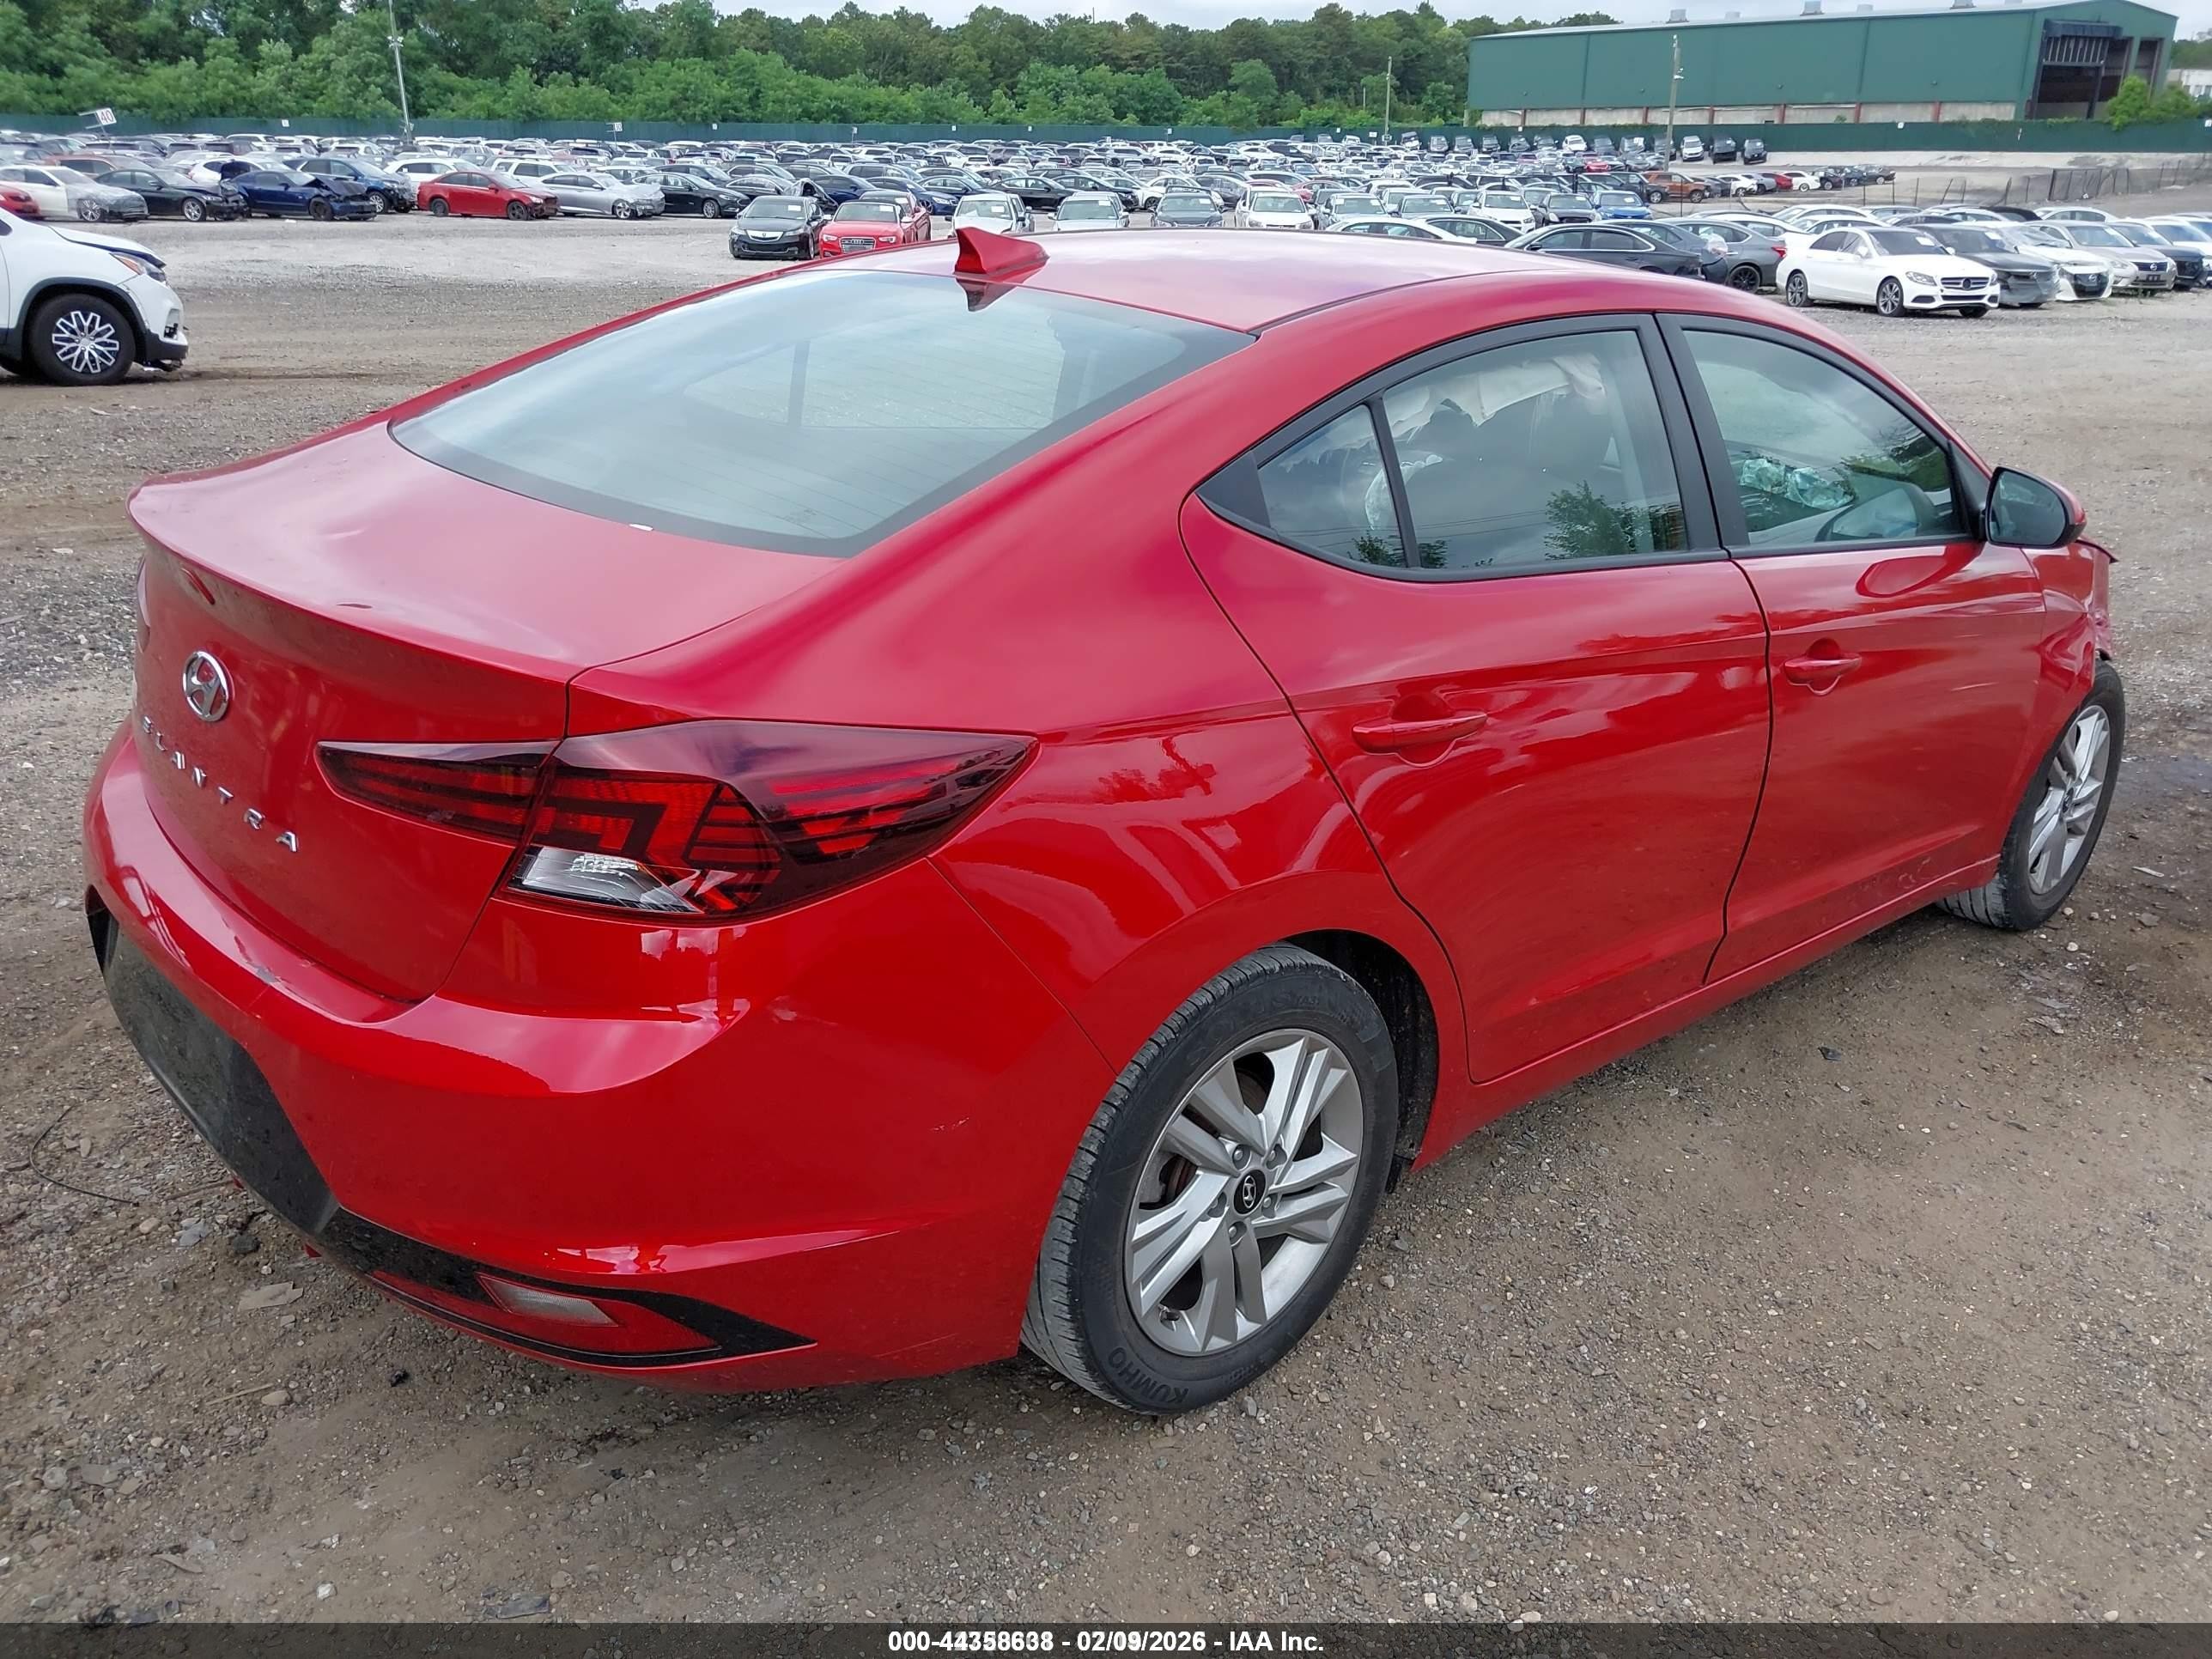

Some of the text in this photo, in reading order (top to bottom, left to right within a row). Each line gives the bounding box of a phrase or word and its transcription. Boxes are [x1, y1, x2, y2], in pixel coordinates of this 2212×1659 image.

[101, 110, 113, 123] 40
[142, 715, 299, 853] ELANTRA
[1108, 1346, 1189, 1404] KUMHO
